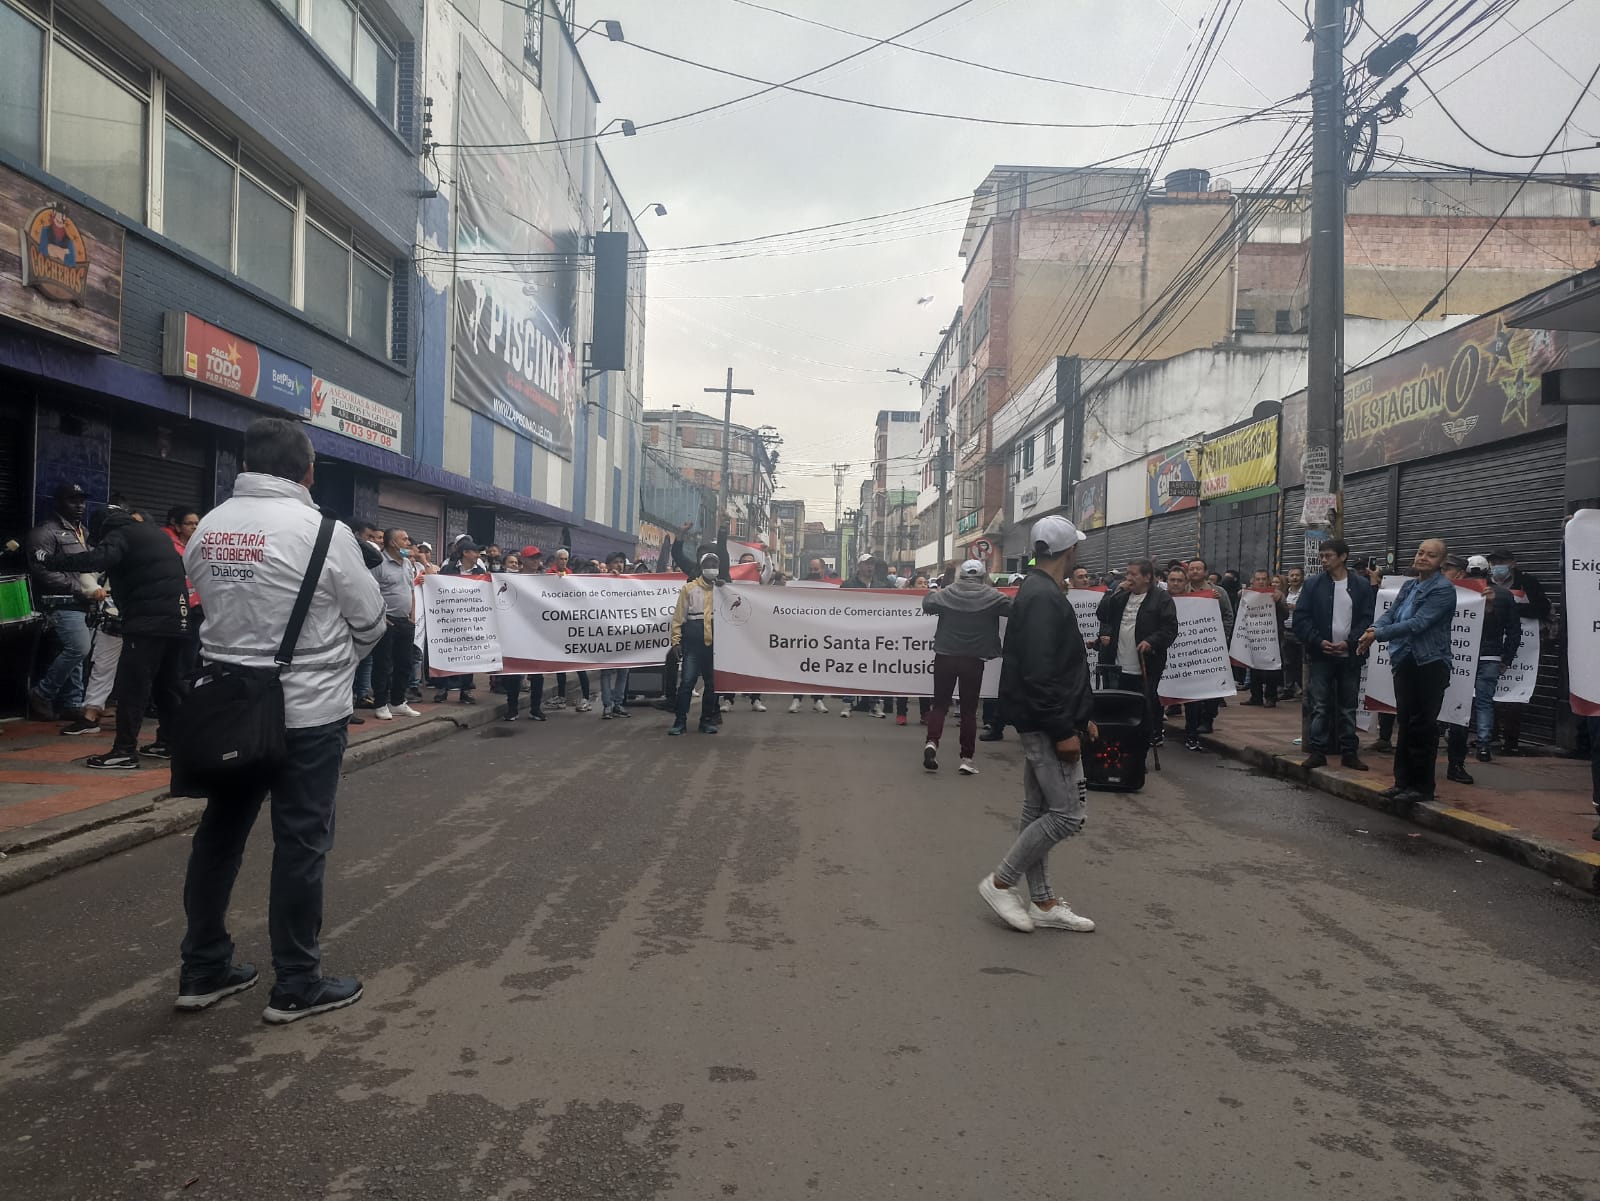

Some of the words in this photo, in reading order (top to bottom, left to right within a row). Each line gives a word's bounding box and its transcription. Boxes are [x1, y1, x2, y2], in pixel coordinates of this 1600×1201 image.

[30, 245, 86, 295] COCHEROS
[211, 346, 230, 360] PAGA
[489, 295, 559, 401] PISCINA
[206, 353, 242, 380] TODO
[206, 371, 222, 384] PARA
[272, 369, 295, 391] BetPlay
[1360, 366, 1444, 432] ESTACIÓN
[345, 421, 364, 438] 703
[366, 429, 378, 442] 97
[380, 434, 392, 447] 08
[1223, 431, 1272, 469] PARQUEADERO
[1171, 481, 1197, 489] ABIERTO
[1177, 488, 1198, 496] HORAS
[201, 529, 266, 547] SECRETARÍA
[201, 547, 213, 560] DE
[216, 547, 264, 562] GOBIERNO
[1571, 558, 1600, 574] Exig
[600, 588, 655, 597] Comerciantes
[656, 588, 670, 596] ZAI
[541, 608, 638, 621] COMERCIANTES
[641, 607, 656, 618] EN
[659, 606, 676, 616] CO
[829, 606, 842, 616] de
[844, 606, 913, 616] Comerciantes
[1463, 610, 1477, 619] Fe
[441, 626, 473, 634] mejoren
[568, 626, 585, 637] DE
[588, 626, 604, 637] LA
[607, 622, 672, 636] EXPLOTACI
[1188, 628, 1198, 636] 20
[430, 636, 474, 644] condiciones
[564, 642, 612, 654] SEXUAL
[615, 641, 631, 652] DE
[634, 638, 672, 650] MENO
[769, 634, 819, 649] Barrio
[823, 635, 870, 650] Santa
[875, 636, 899, 651] Fe:
[902, 636, 935, 651] Terr
[1450, 638, 1470, 648] ajo
[454, 644, 482, 652] habitan
[799, 657, 821, 672] de
[825, 658, 854, 673] Paz
[858, 661, 868, 673] e
[872, 658, 935, 674] Inclusió
[1451, 666, 1471, 677] tías
[1520, 662, 1534, 671] los
[1160, 671, 1181, 680] exual
[1182, 670, 1193, 678] de
[1515, 673, 1524, 681] el
